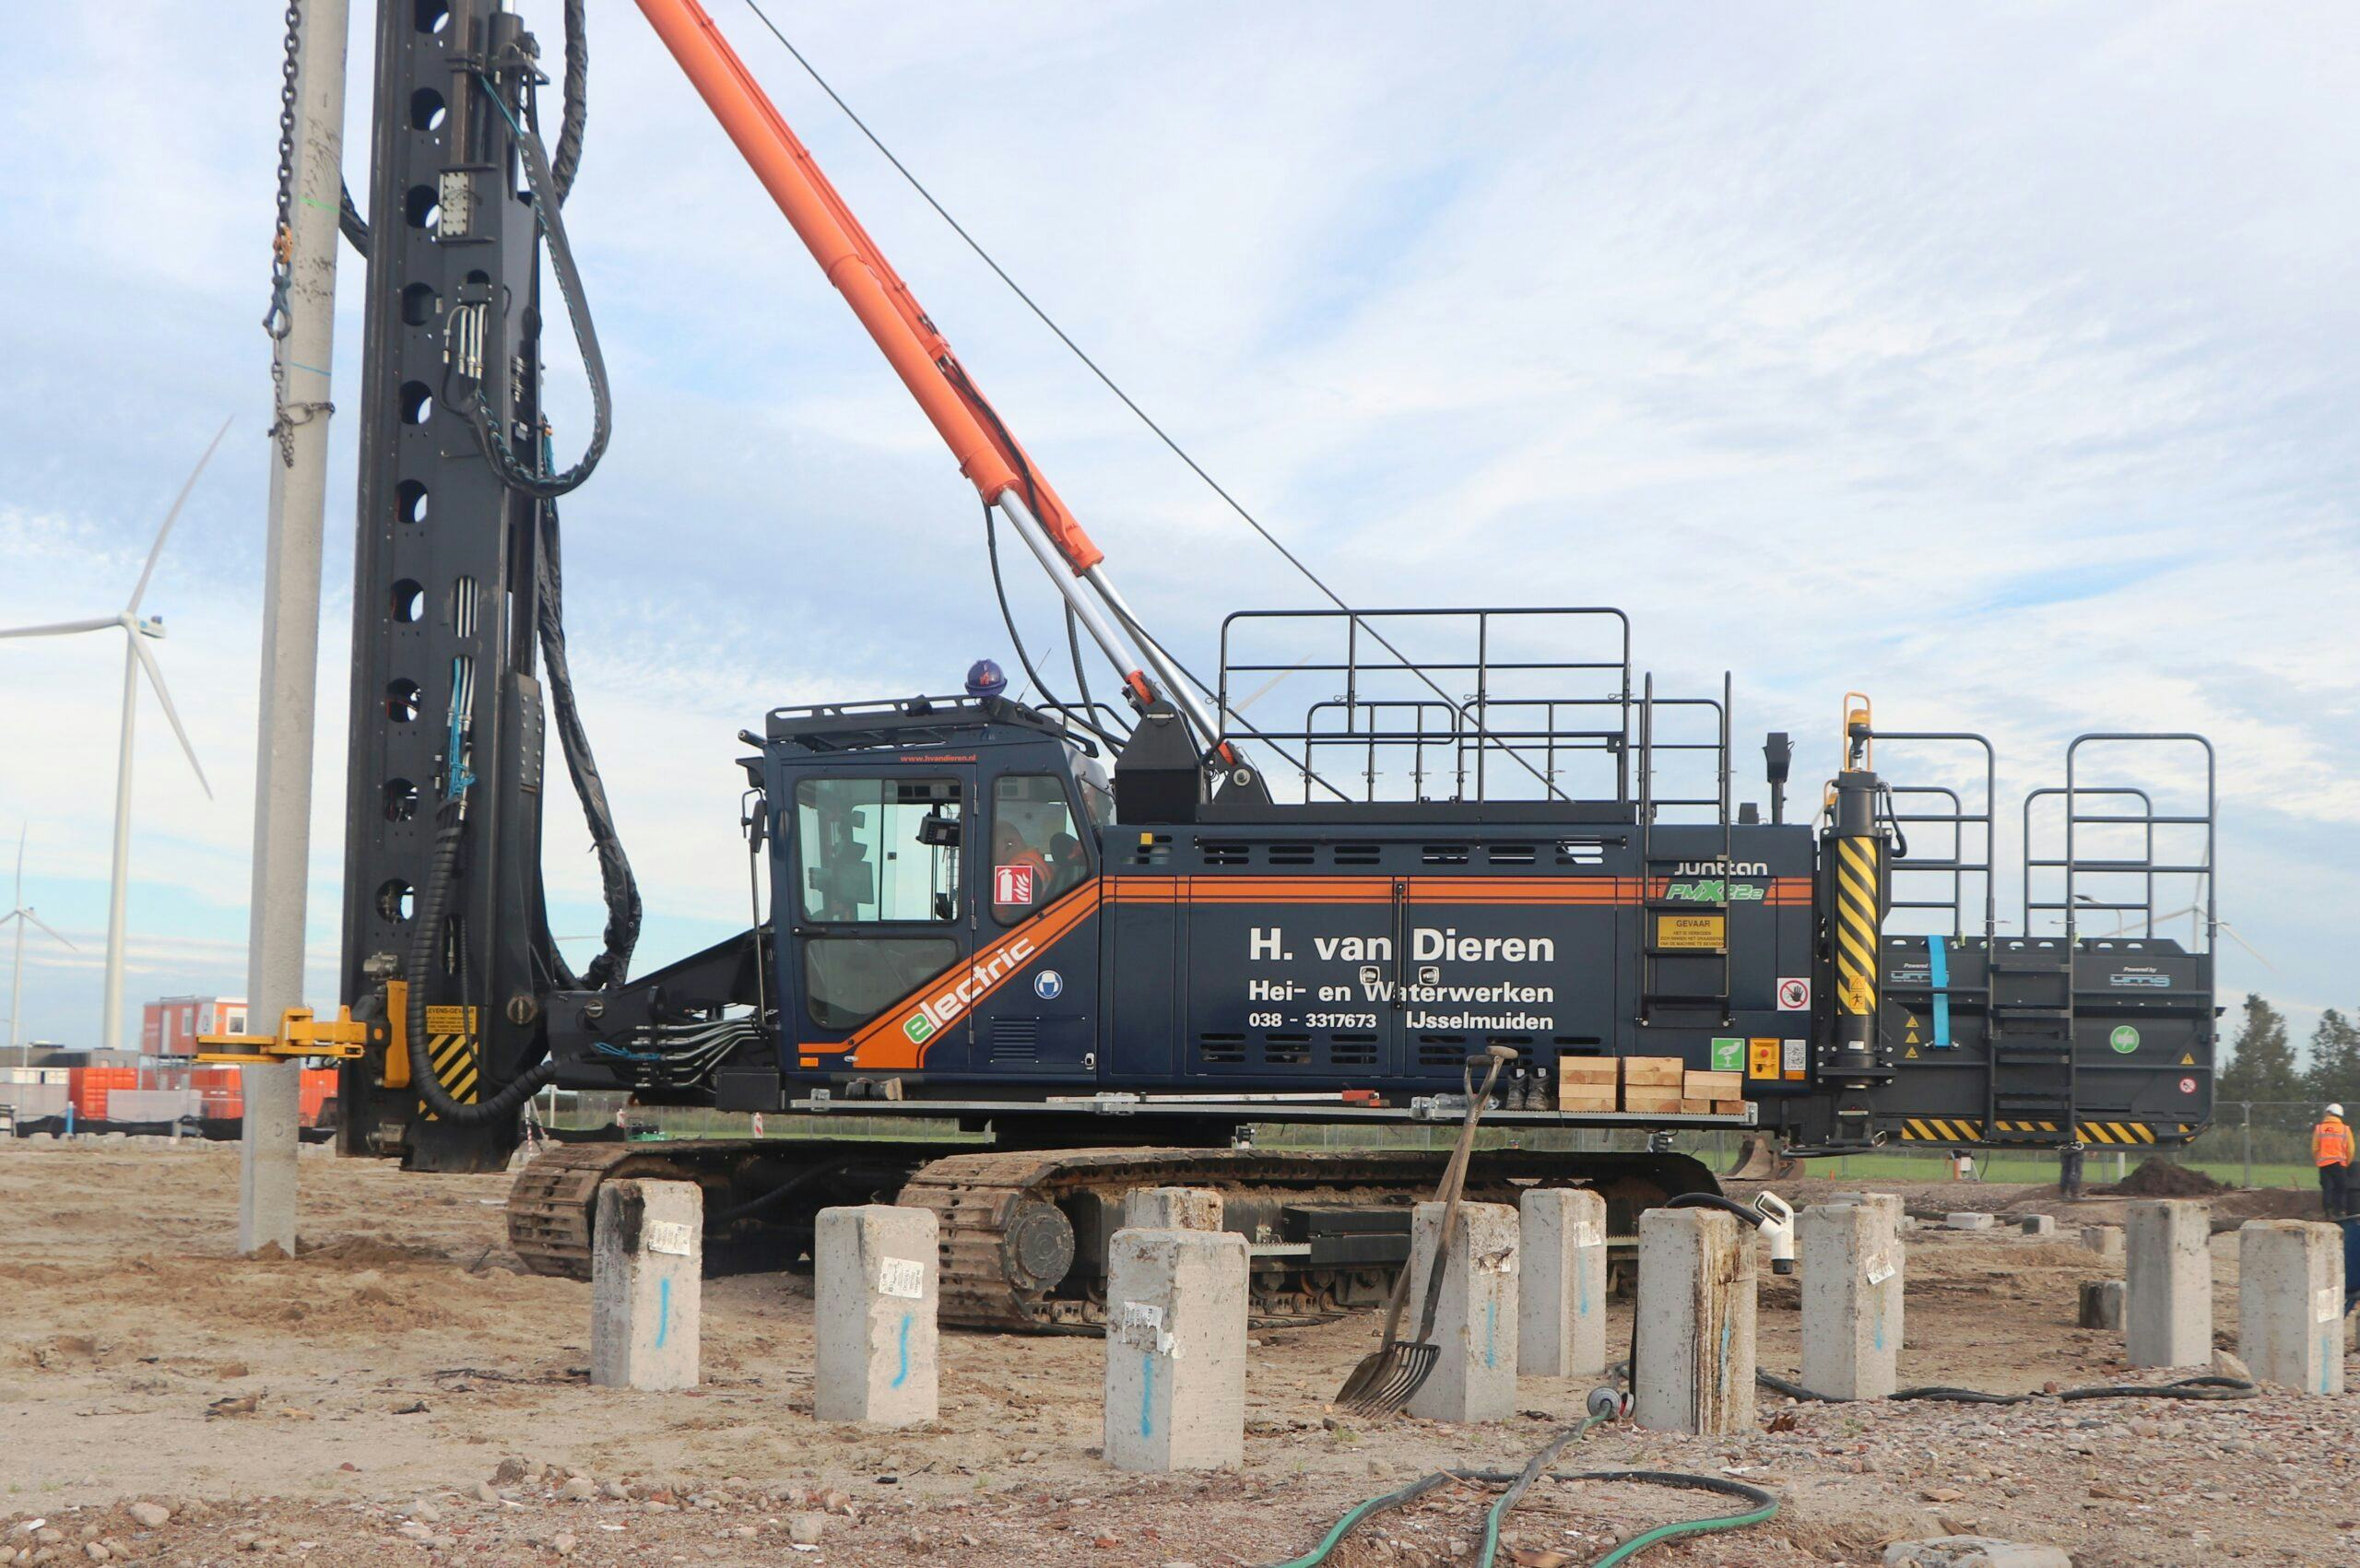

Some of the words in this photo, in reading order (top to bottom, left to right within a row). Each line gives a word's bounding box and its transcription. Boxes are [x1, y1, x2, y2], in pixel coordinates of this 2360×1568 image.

[900, 754, 976, 762] www.hvandieren.nl
[1250, 927, 1293, 960] H.
[1314, 937, 1392, 961] van
[1412, 928, 1554, 961] Dieren
[903, 937, 1036, 1045] electric
[1249, 980, 1306, 1001] Hei-
[1318, 985, 1351, 1001] en
[1363, 981, 1554, 1003] Waterwerken
[1248, 1013, 1283, 1027] 038
[1305, 1013, 1377, 1028] 3317673
[1406, 1011, 1553, 1030] IJsselmuiden
